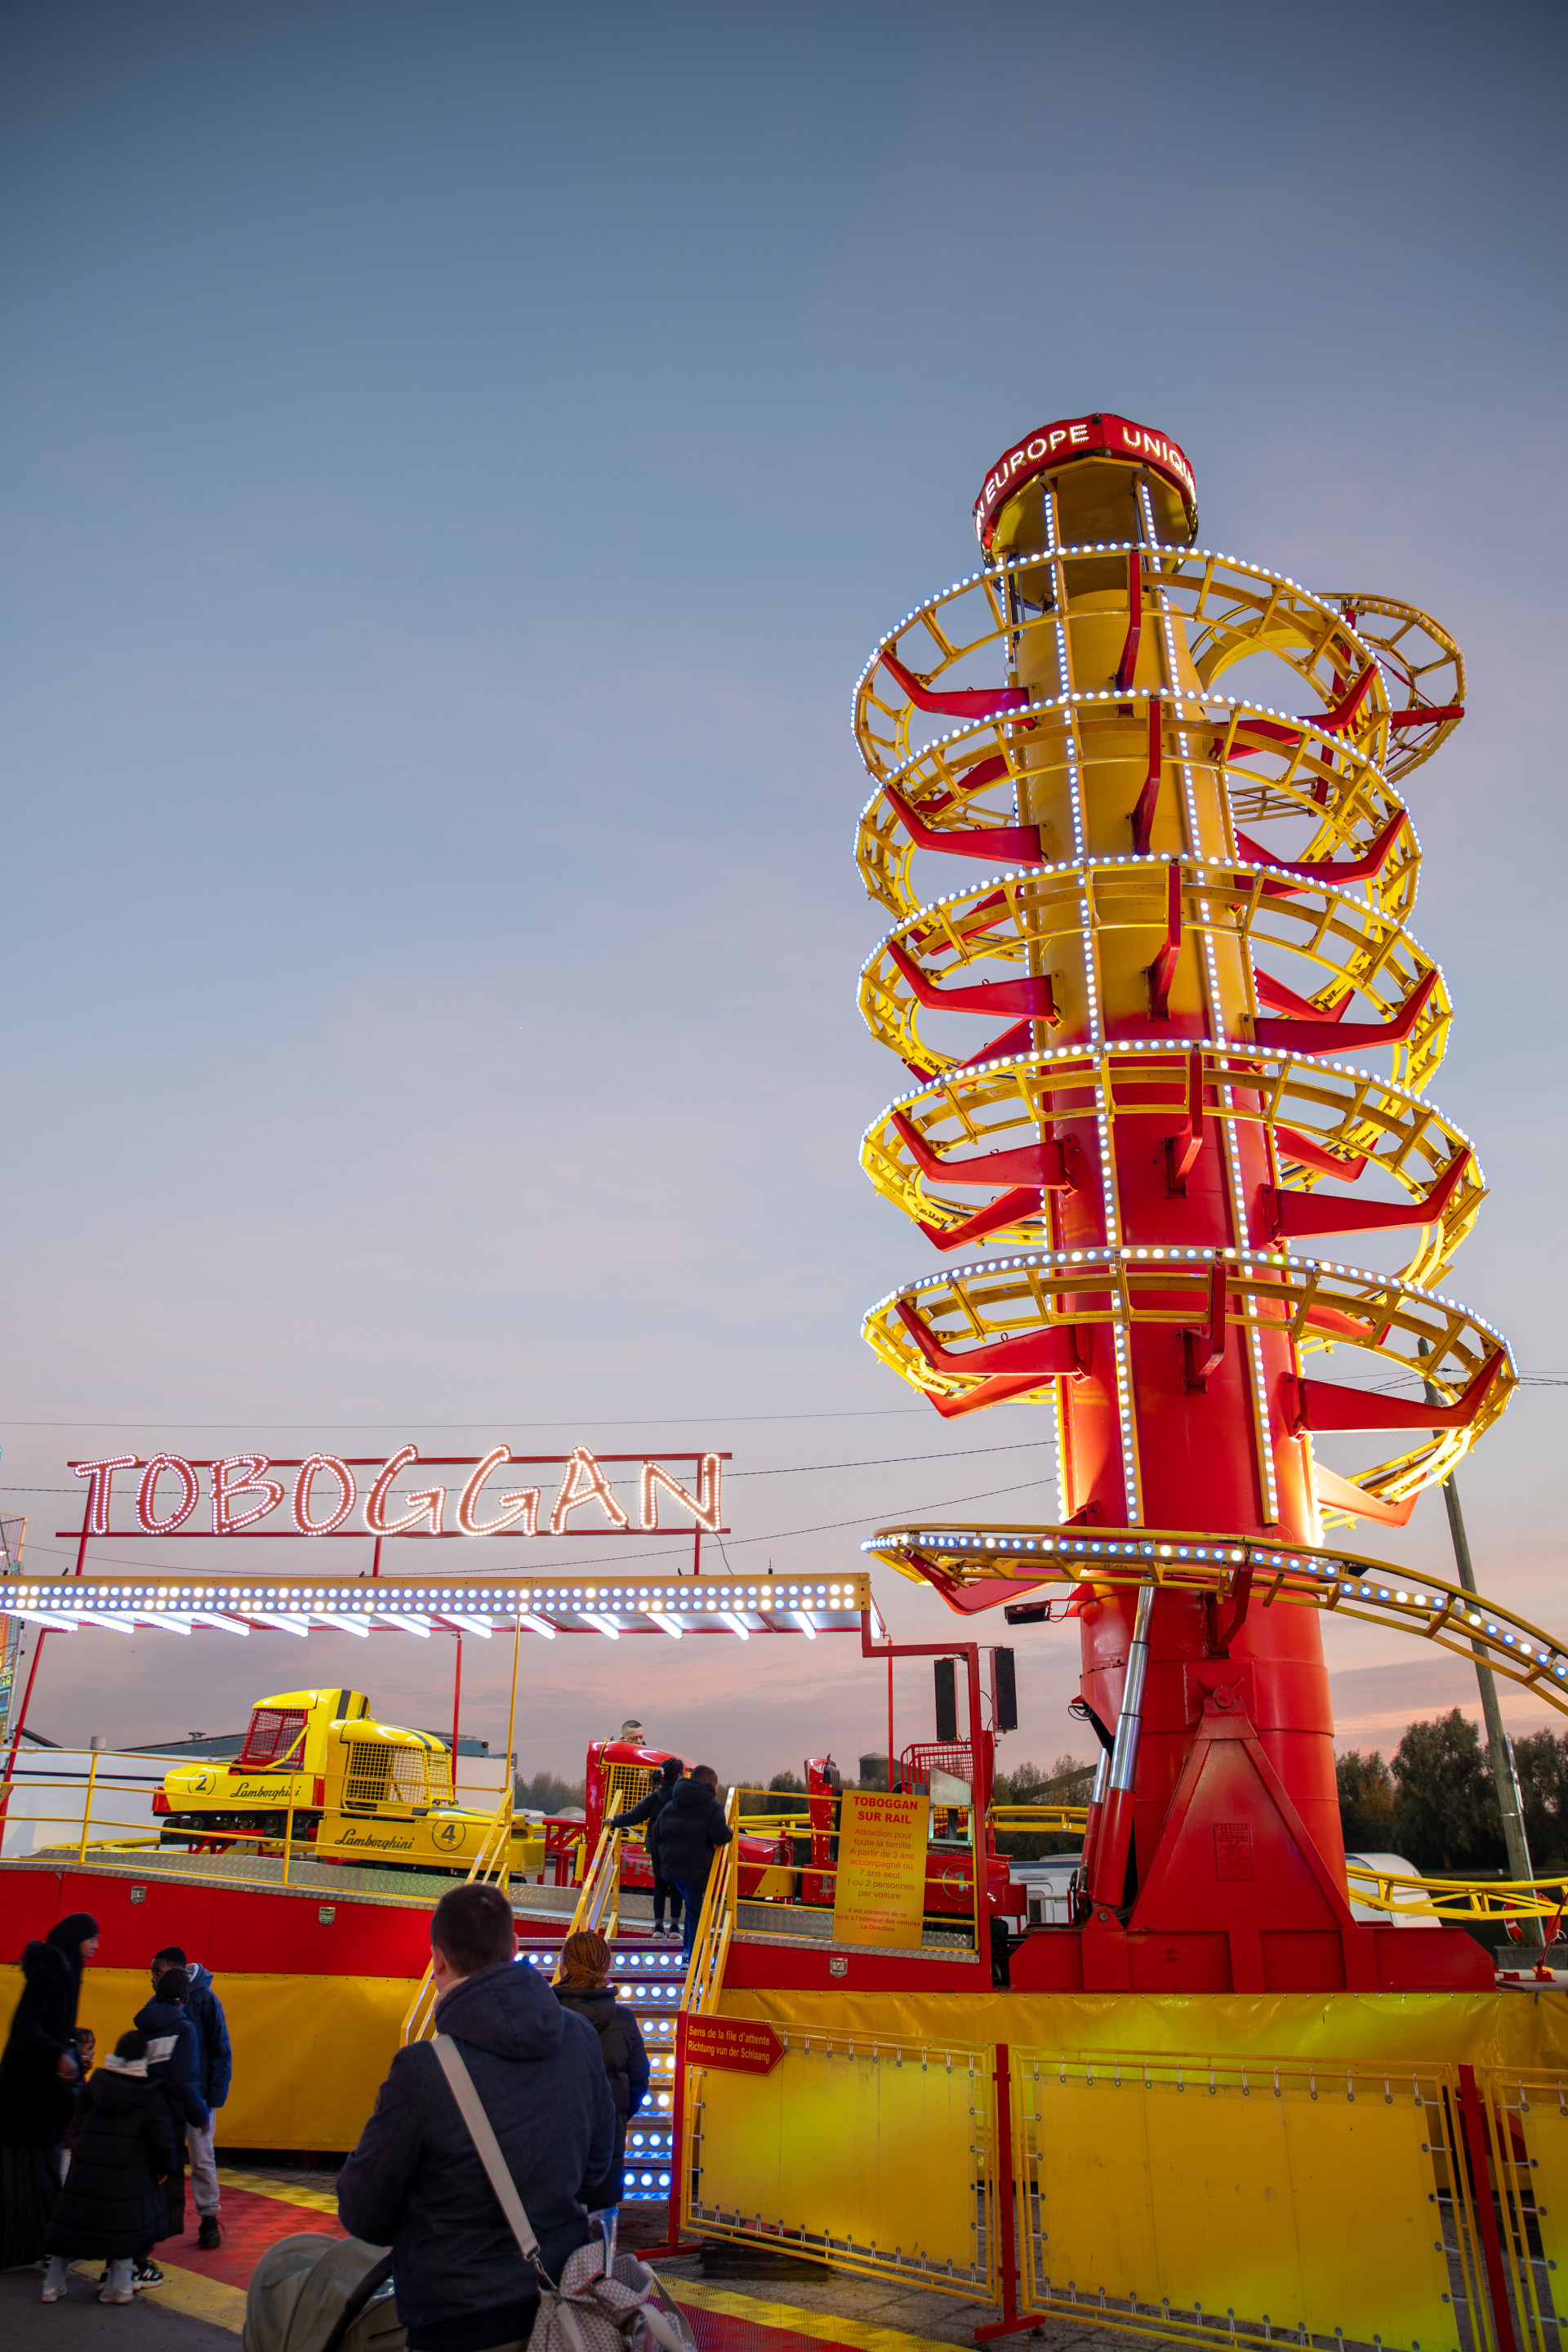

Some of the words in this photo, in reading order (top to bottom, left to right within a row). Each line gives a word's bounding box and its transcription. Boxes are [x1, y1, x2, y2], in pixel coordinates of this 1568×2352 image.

[985, 424, 1089, 505] EUROPE
[74, 1444, 723, 1537] TOBOGGAN
[195, 1774, 208, 1791] 2
[229, 1782, 302, 1801] Lamborghii
[853, 1796, 918, 1811] TOBOGGAN
[858, 1811, 881, 1822] SUR
[884, 1813, 911, 1824] RAIL
[334, 1829, 416, 1851] Lamborghini
[441, 1824, 456, 1844] 4
[854, 1828, 892, 1838] Attraction
[854, 1838, 874, 1846] toute
[885, 1841, 911, 1850] famille
[849, 1859, 901, 1869] accompagné
[865, 1879, 871, 1887] 2
[873, 1882, 915, 1891] personnes
[955, 1871, 965, 1892] 1
[874, 1891, 901, 1900] voiture
[869, 1924, 896, 1932] Direction
[688, 2025, 706, 2038] Sens
[707, 2028, 716, 2038] de
[718, 2029, 724, 2039] la
[726, 2030, 737, 2041] file
[738, 2032, 770, 2046] d'attente
[688, 2040, 715, 2056] Richtung
[716, 2047, 728, 2056] vun
[728, 2047, 739, 2057] der
[741, 2048, 770, 2064] Schlaang
